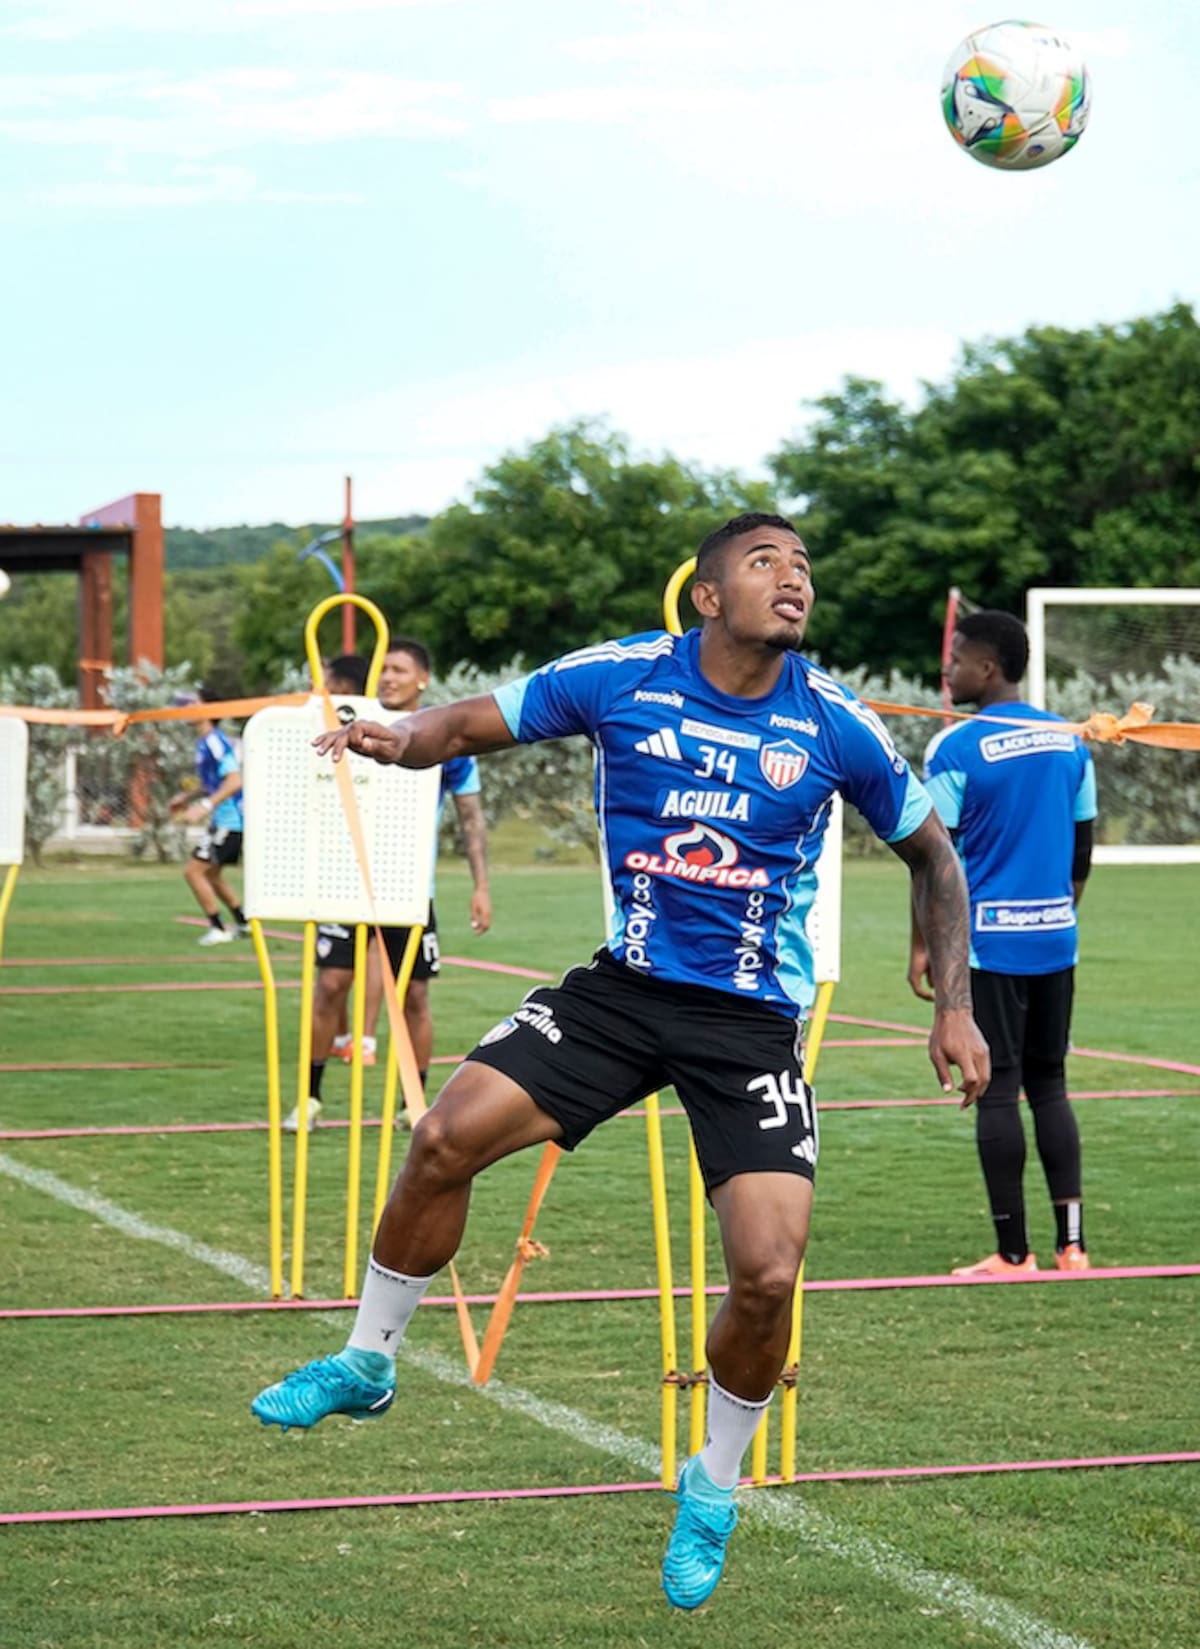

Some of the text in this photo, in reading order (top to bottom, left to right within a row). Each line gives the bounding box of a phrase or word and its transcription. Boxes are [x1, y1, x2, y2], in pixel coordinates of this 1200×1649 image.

[694, 745, 737, 784] 34
[660, 789, 751, 822] AGUILA
[624, 852, 771, 888] OLIMPICA
[624, 872, 657, 975] play.co
[746, 1069, 811, 1130] 34
